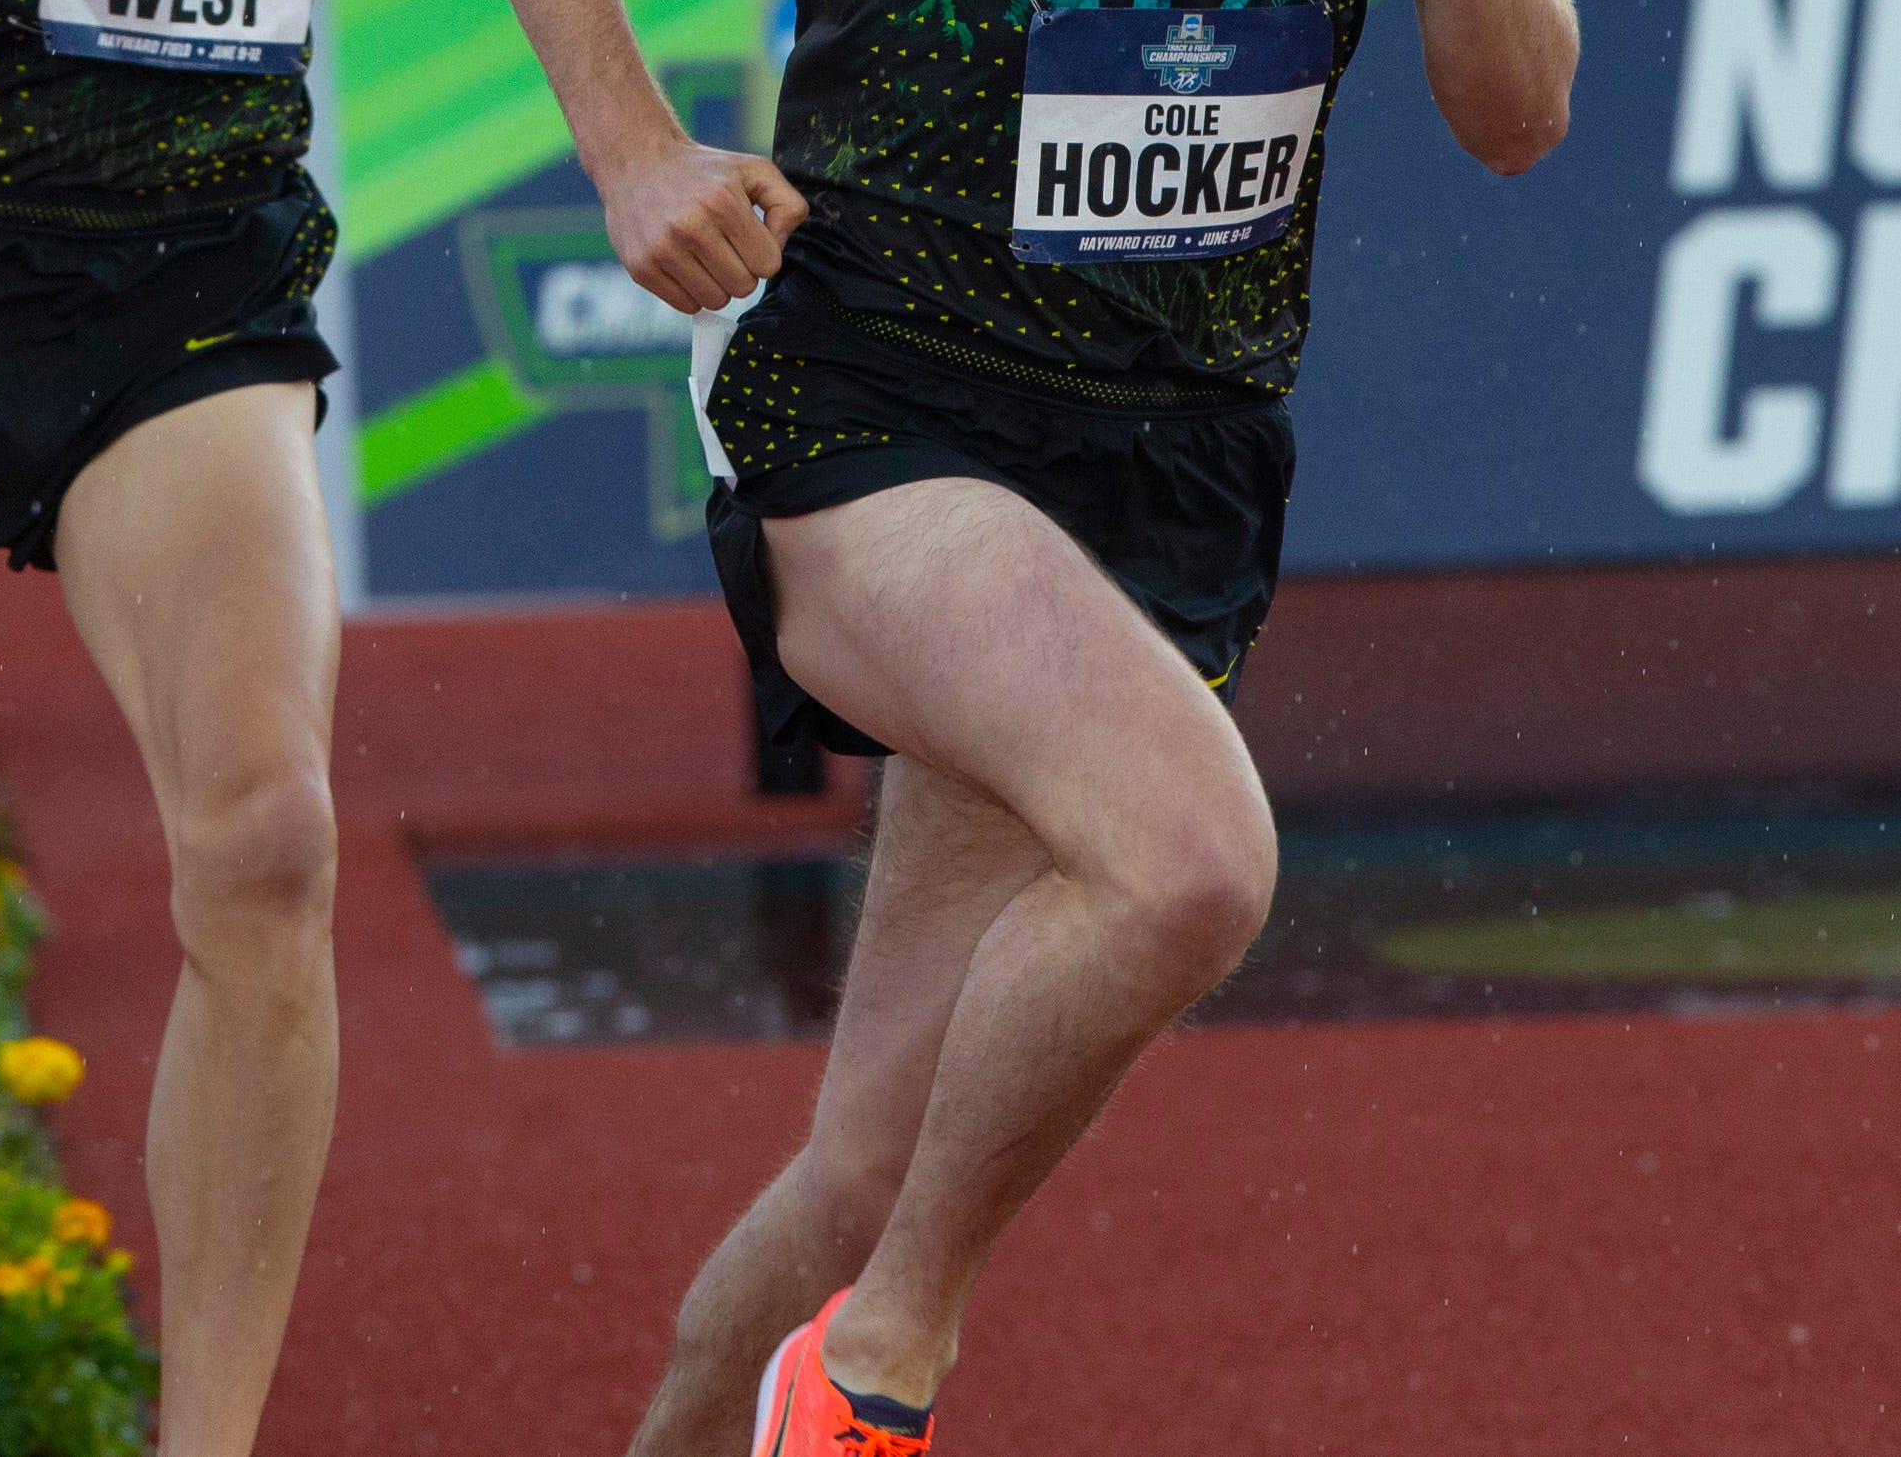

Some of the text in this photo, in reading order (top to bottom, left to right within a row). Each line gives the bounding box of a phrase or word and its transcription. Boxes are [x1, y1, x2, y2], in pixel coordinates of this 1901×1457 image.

[1148, 51, 1228, 63] CHAMPIONSHIPS
[1144, 103, 1222, 137] COLE
[1035, 133, 1300, 218] HOCKER
[1078, 225, 1253, 252] HAYWARD FIELD JUNE 9-12
